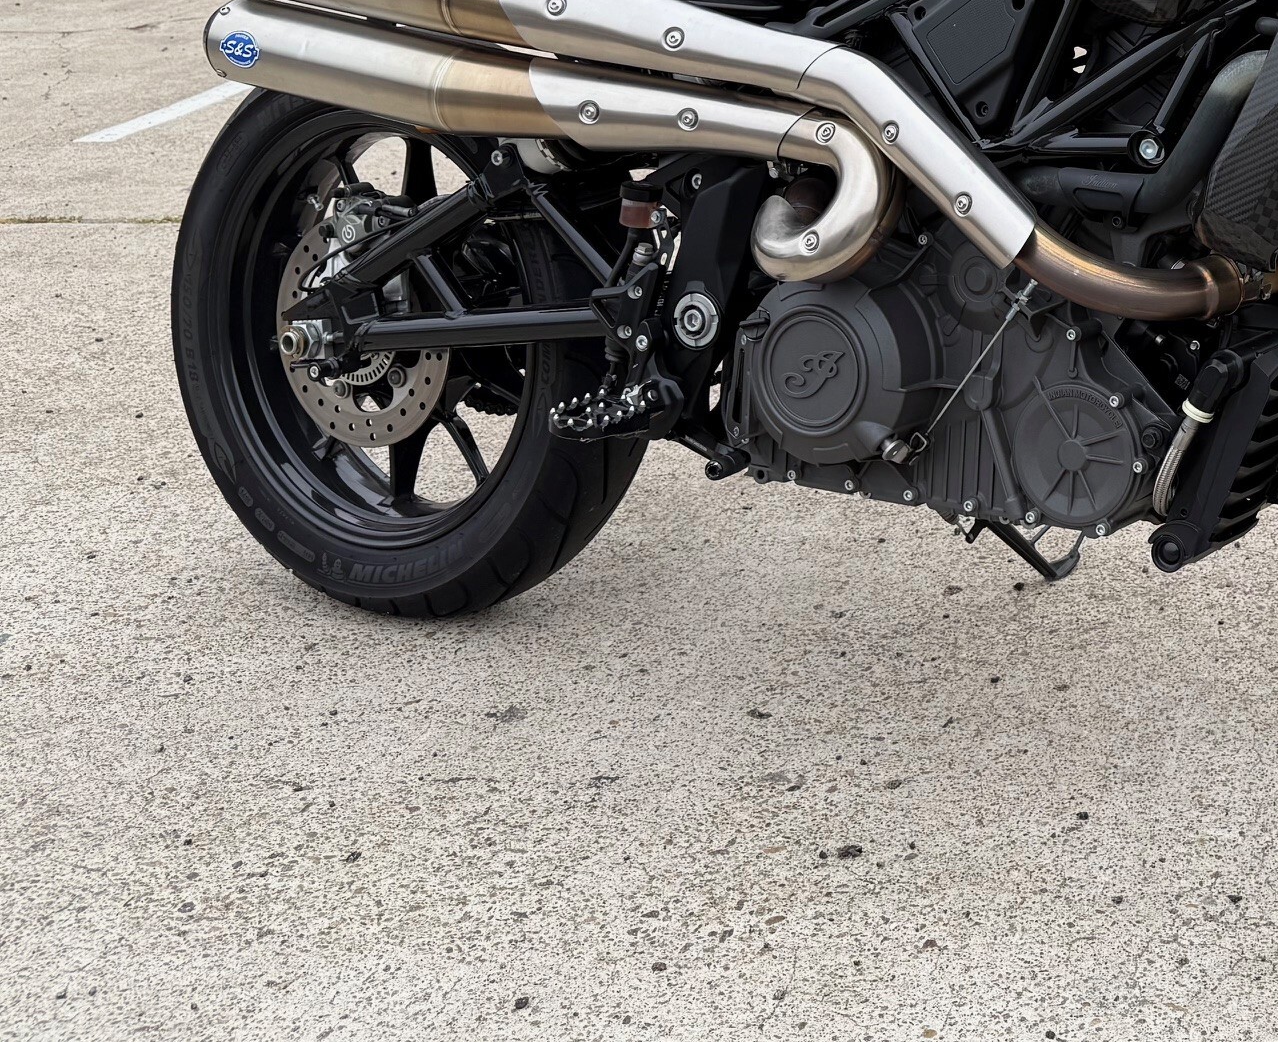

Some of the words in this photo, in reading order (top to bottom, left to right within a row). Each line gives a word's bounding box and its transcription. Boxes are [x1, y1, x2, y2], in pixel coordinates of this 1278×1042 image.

[224, 40, 254, 58] S&S
[1047, 389, 1074, 400] INDIAN
[1073, 389, 1124, 429] MOTORCYCLE
[348, 537, 465, 585] MICHELIN
